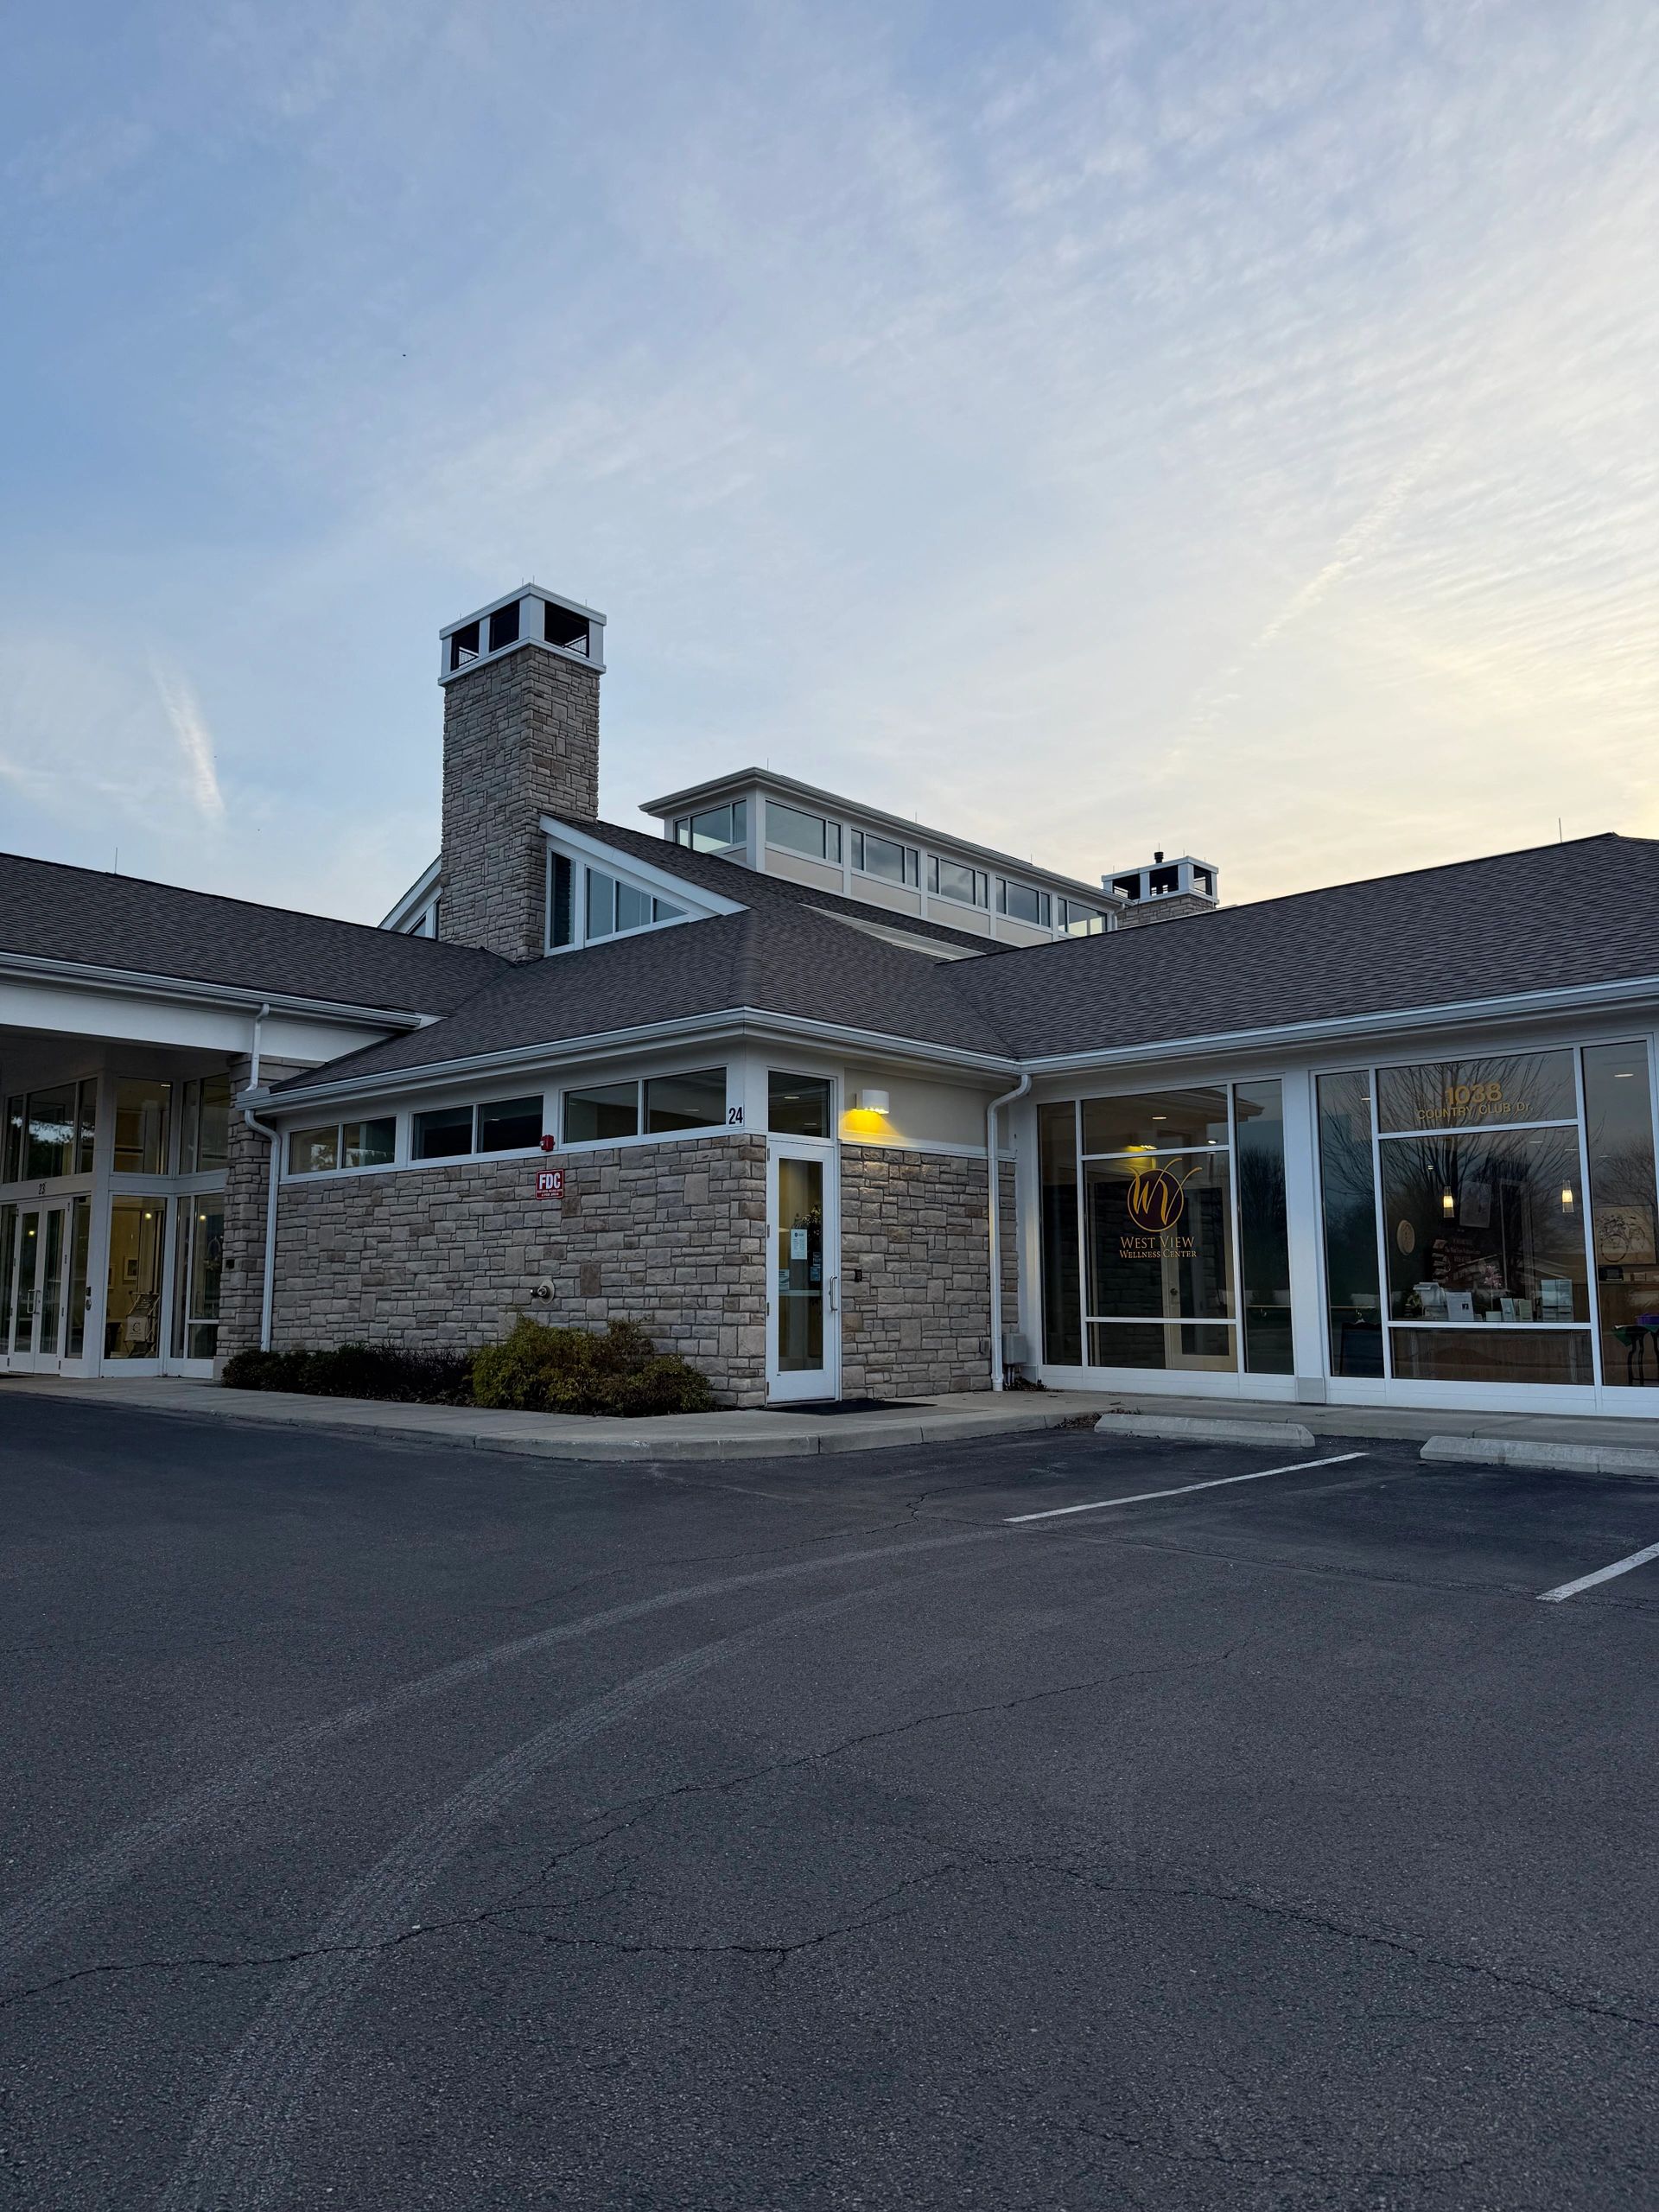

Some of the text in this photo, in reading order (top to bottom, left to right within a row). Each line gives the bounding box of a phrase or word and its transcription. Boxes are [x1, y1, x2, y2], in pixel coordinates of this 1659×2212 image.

[1445, 1082, 1503, 1105] 1038
[728, 1106, 743, 1124] 24
[1417, 1106, 1472, 1120] COUNTRY
[1478, 1102, 1511, 1115] CLUB
[539, 1172, 561, 1190] FDC
[1120, 1235, 1195, 1249] WEST VIEW
[1119, 1248, 1197, 1259] WELLNESS CENTER
